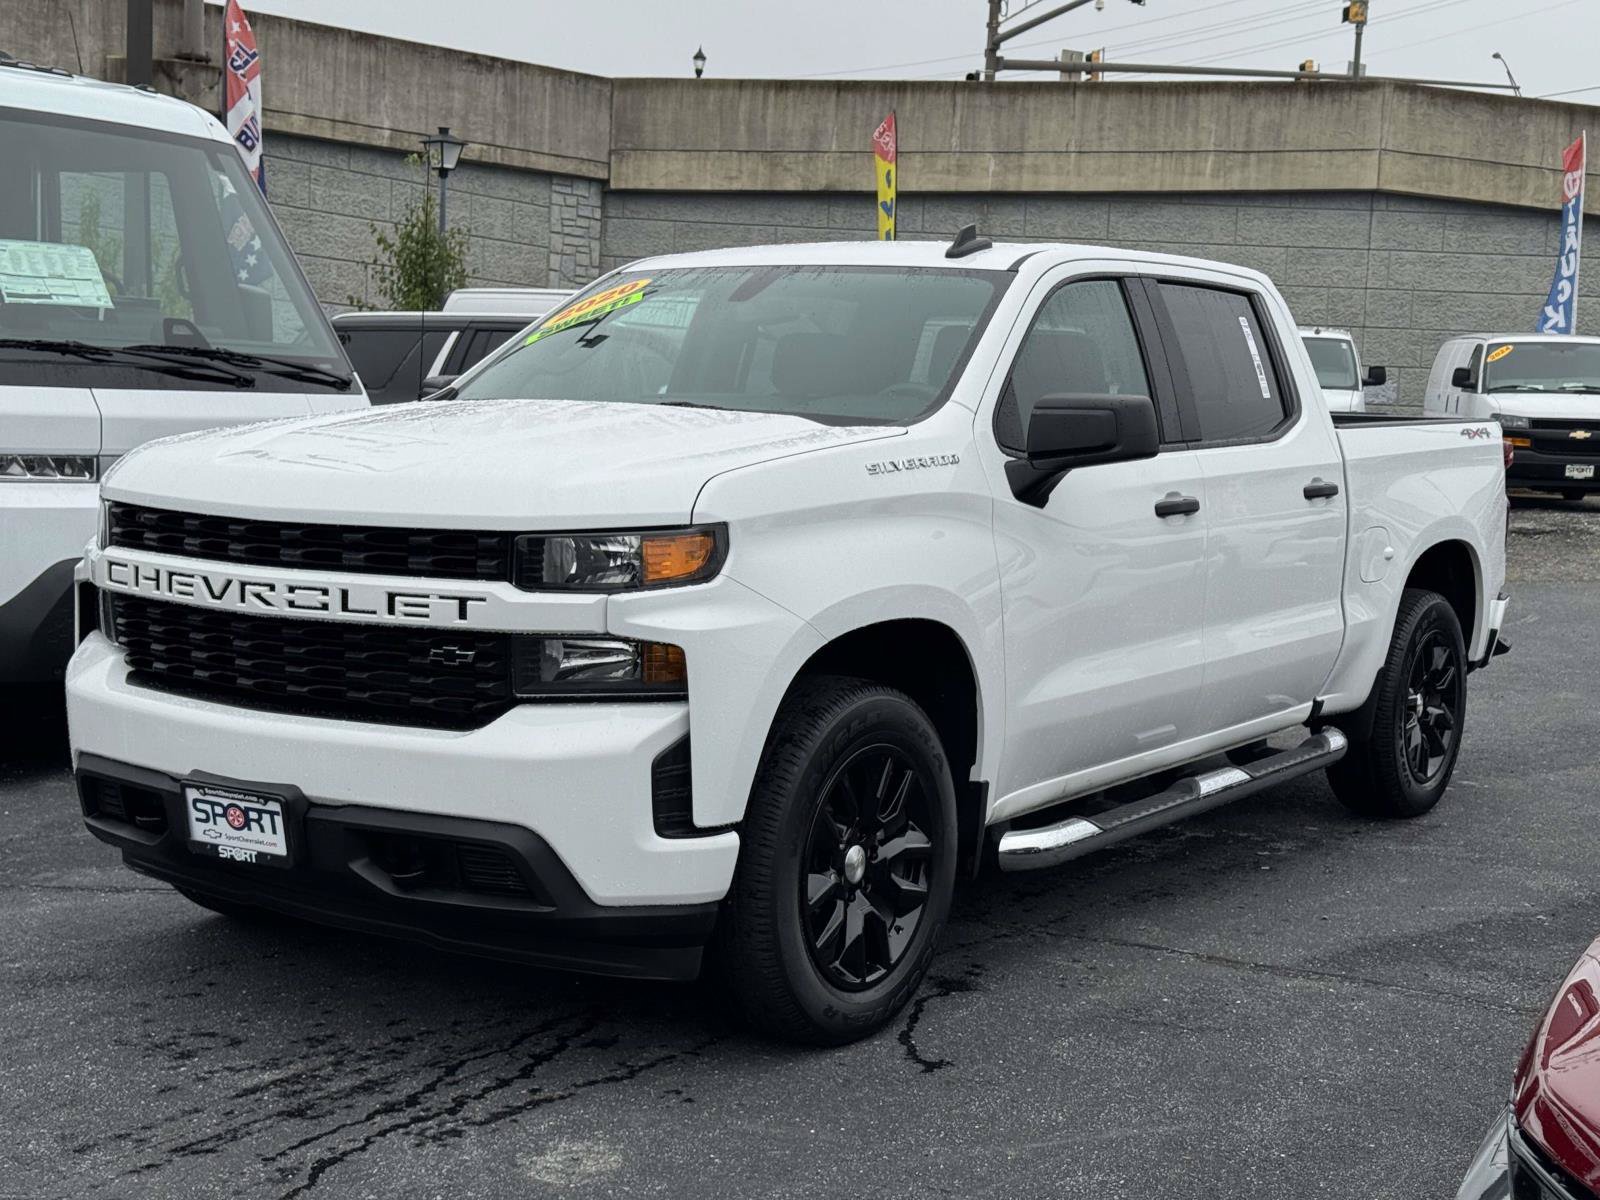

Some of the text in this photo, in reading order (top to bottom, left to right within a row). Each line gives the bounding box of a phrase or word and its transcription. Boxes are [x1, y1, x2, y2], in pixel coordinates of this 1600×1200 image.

[553, 282, 640, 323] 2020
[864, 454, 960, 475] SILVERADO
[1567, 466, 1593, 475] SPORT
[105, 559, 488, 624] CHEVROLET
[191, 797, 281, 836] SPORT
[217, 844, 258, 863] SPORT
